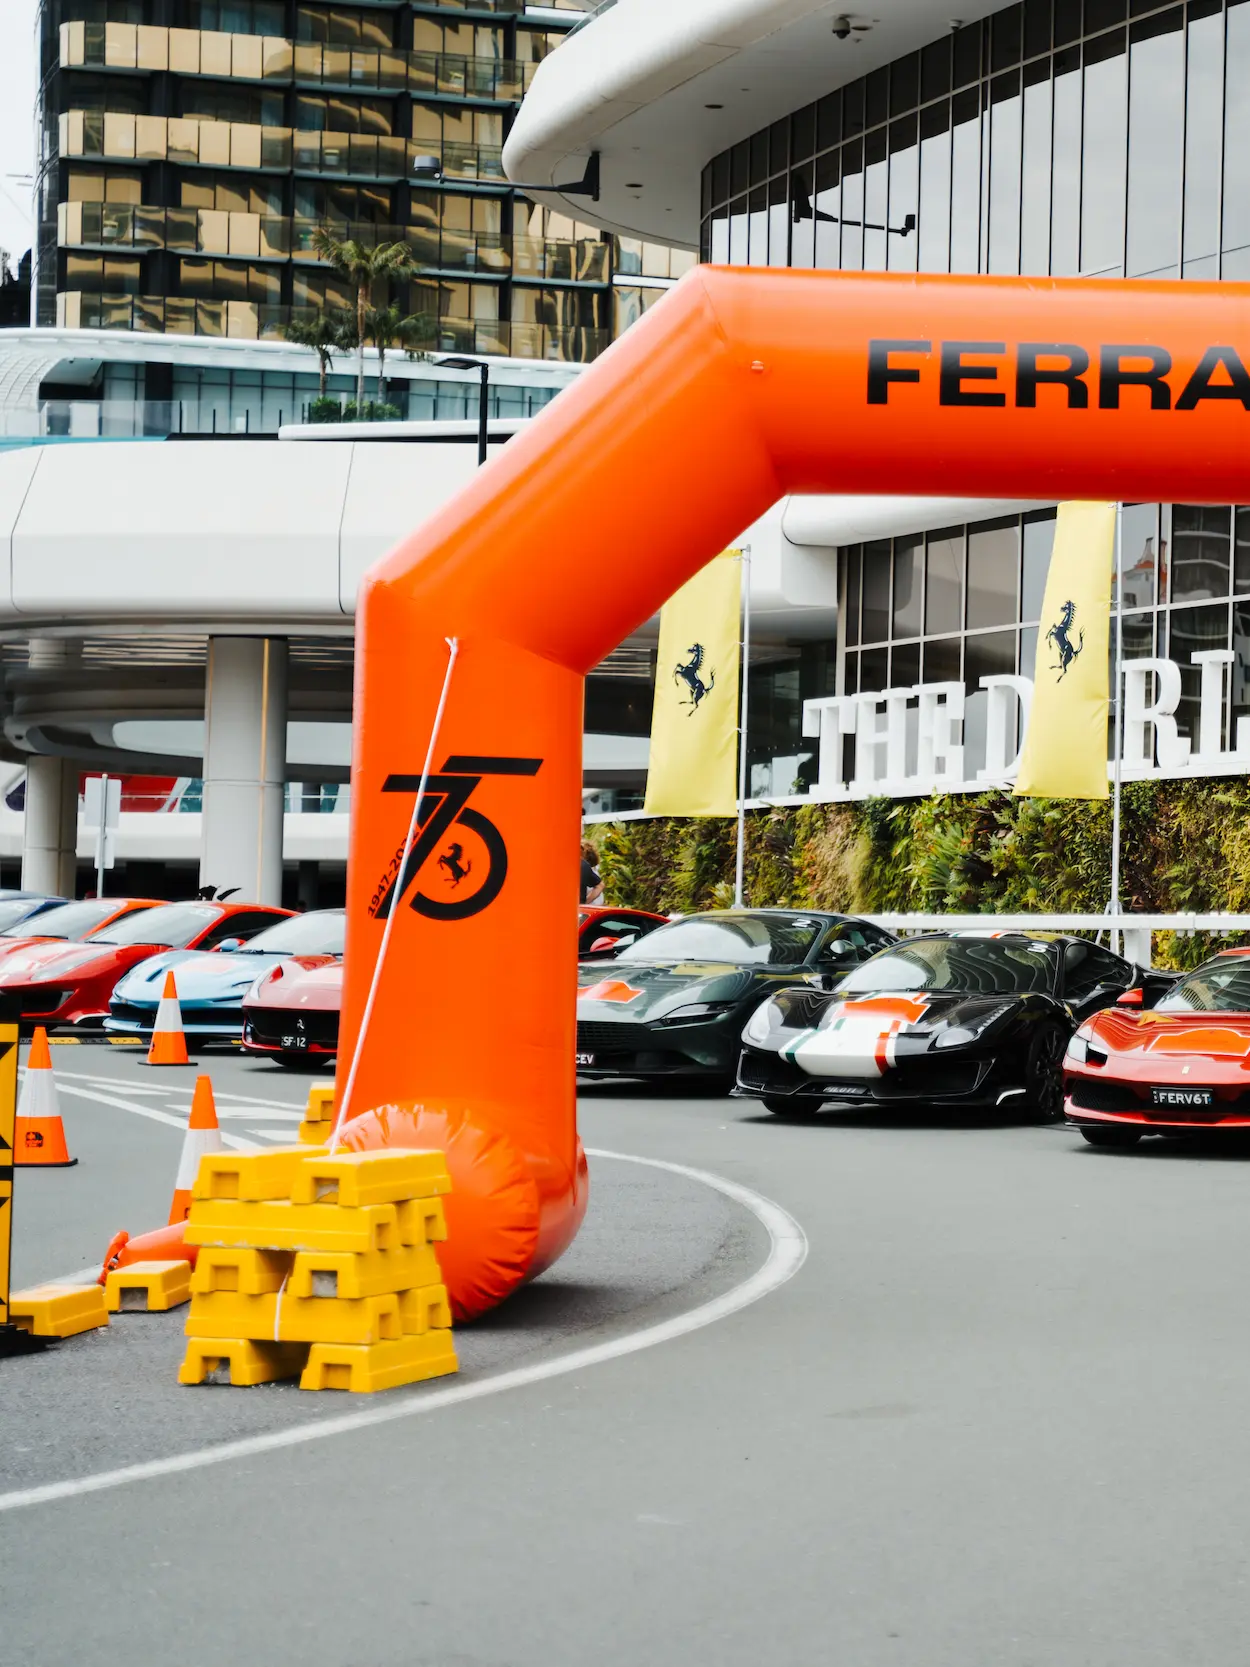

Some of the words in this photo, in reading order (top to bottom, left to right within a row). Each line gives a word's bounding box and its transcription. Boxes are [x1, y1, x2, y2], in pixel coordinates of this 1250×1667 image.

[802, 681, 966, 795] THE
[374, 755, 544, 921] 75
[1159, 1092, 1210, 1105] FERV6T
